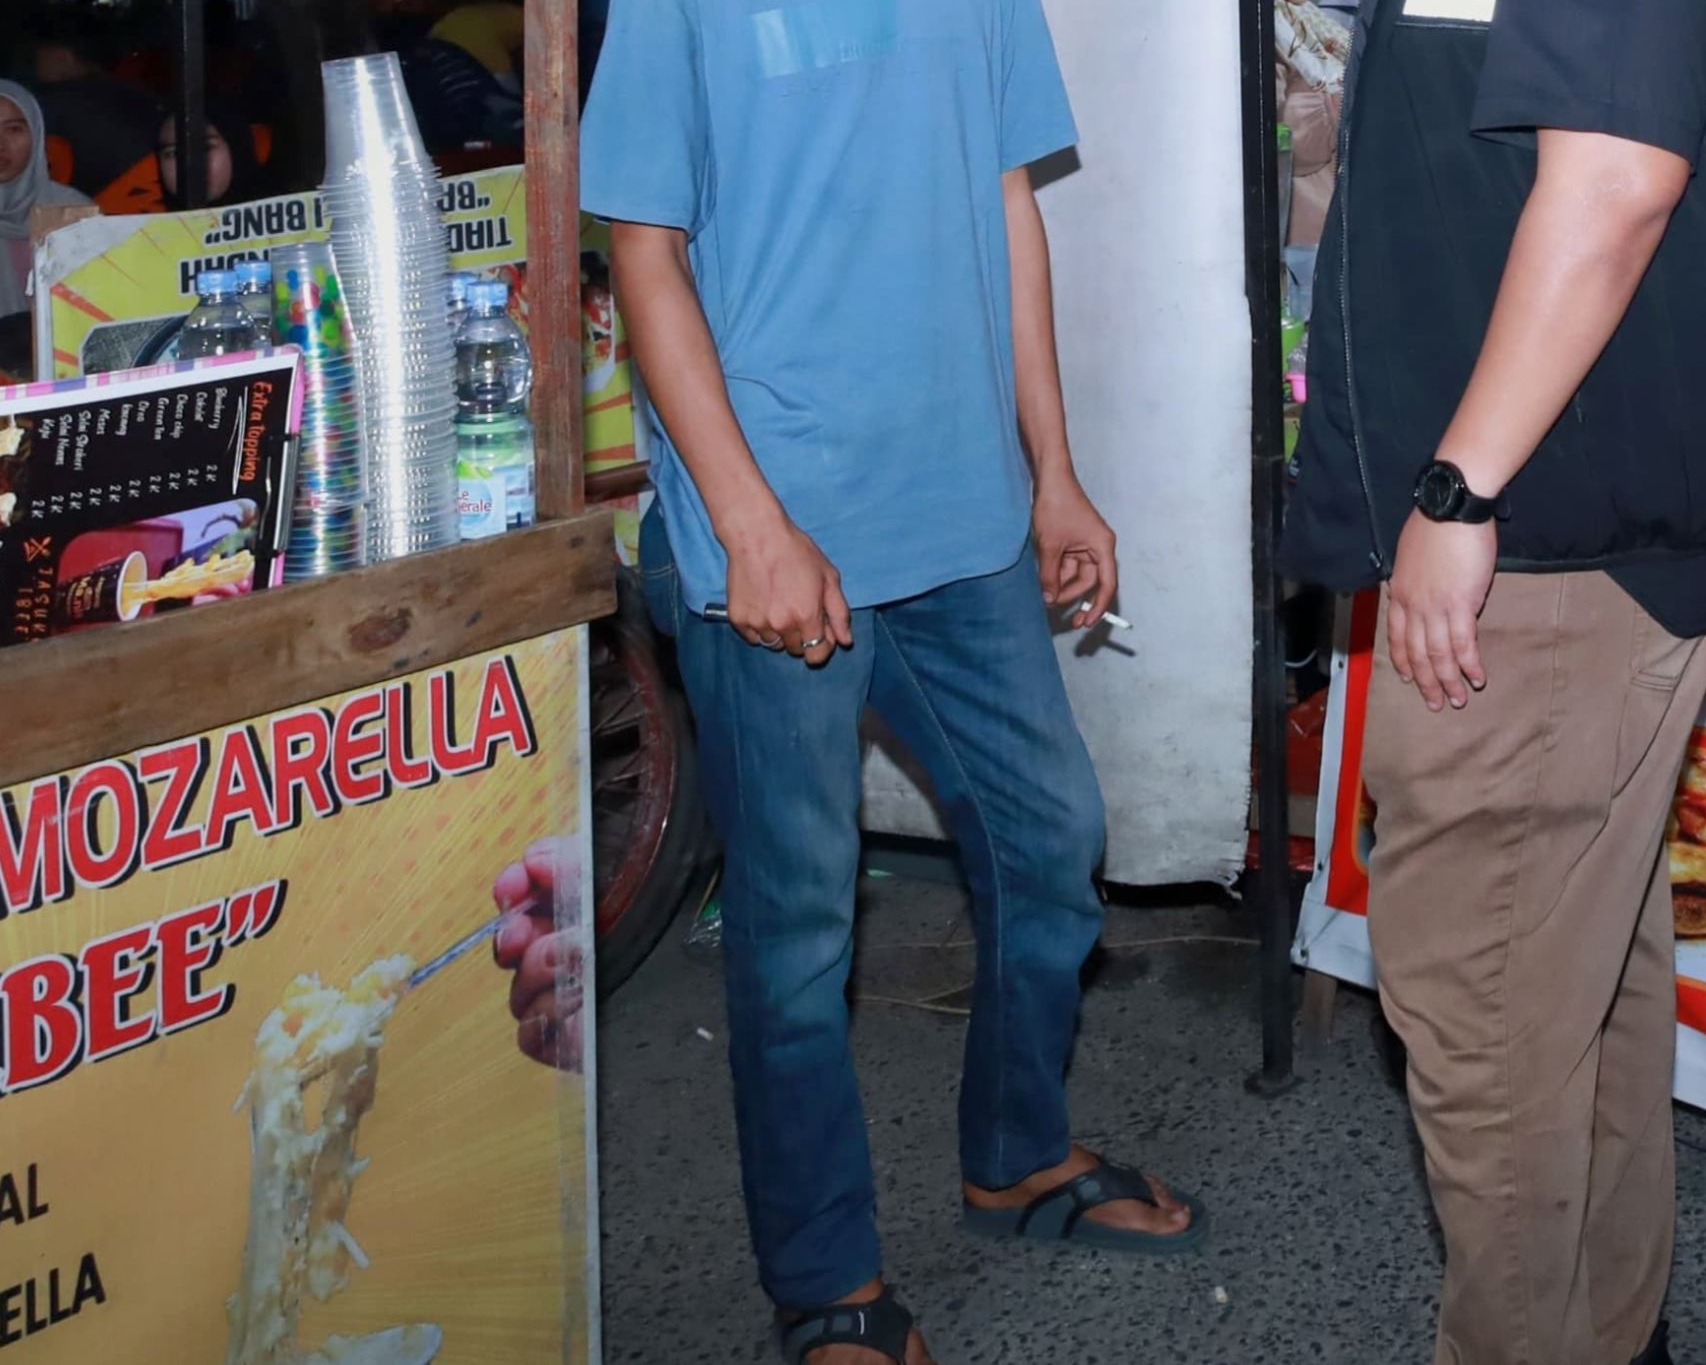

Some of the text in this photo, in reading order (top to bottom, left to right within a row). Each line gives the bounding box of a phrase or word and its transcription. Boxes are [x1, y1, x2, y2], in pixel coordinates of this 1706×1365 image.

[240, 382, 272, 481] Extra topping
[0, 656, 537, 914] MOZARELLA
[0, 880, 286, 1094] BEE”
[0, 1162, 49, 1226] AL
[0, 1252, 106, 1348] ELLA
